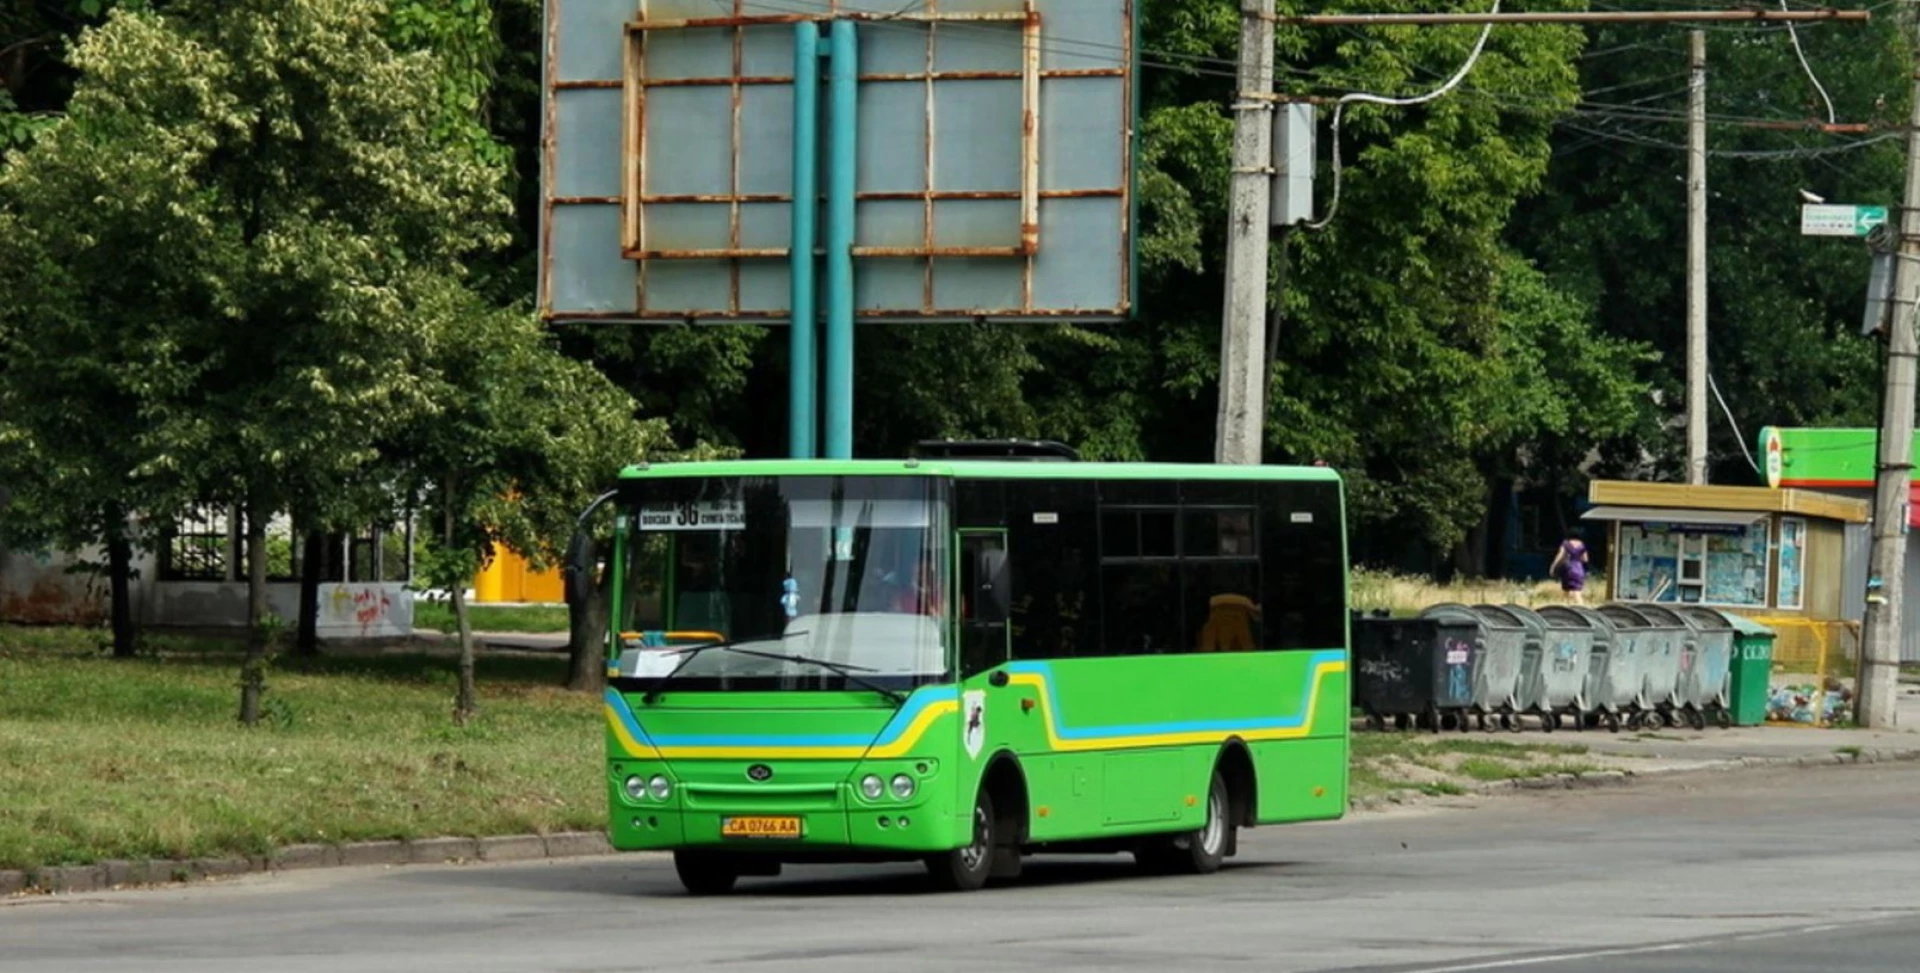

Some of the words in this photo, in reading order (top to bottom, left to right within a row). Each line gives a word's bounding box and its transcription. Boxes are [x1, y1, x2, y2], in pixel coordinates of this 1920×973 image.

[676, 502, 699, 526] 36
[730, 819, 746, 832] CA
[749, 819, 776, 832] 0766
[780, 819, 797, 832] AA
